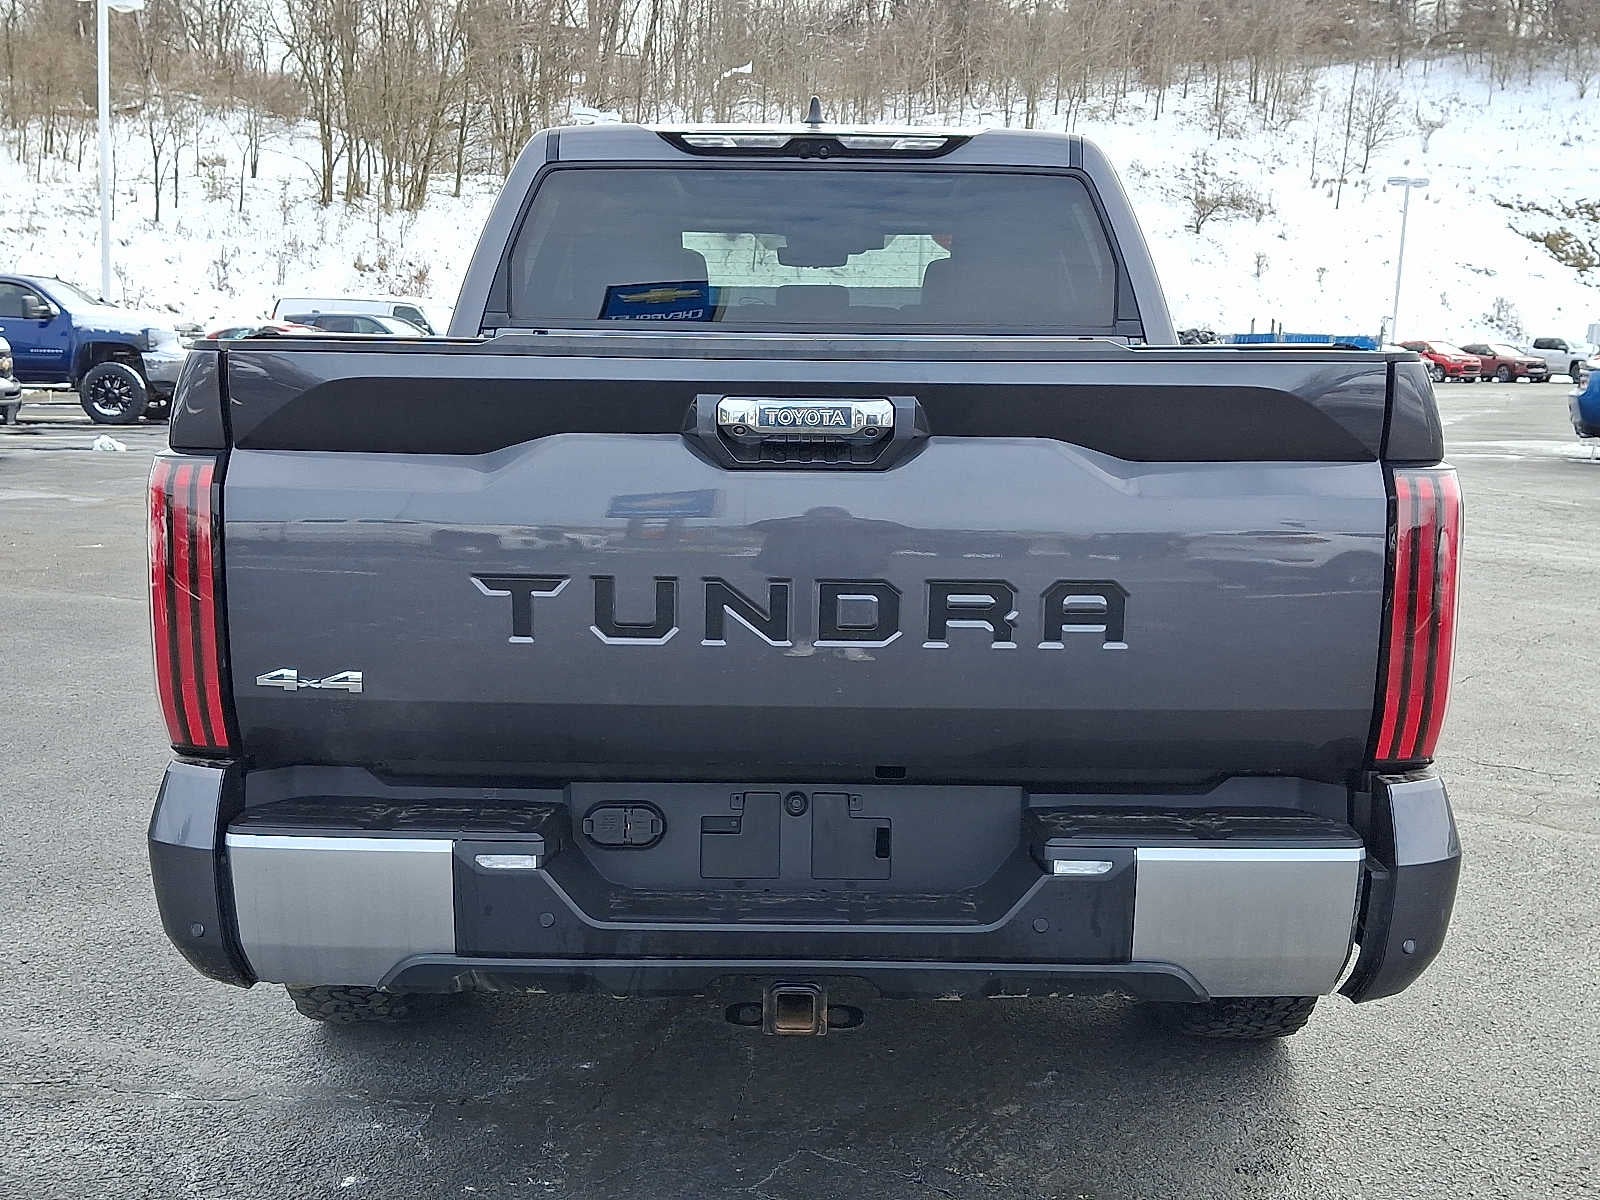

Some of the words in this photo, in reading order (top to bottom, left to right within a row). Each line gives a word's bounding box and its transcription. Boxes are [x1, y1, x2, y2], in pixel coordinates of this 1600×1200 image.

[764, 408, 847, 426] TOYOTA
[469, 574, 1132, 651] TUNDRA
[256, 669, 363, 693] 4x4
